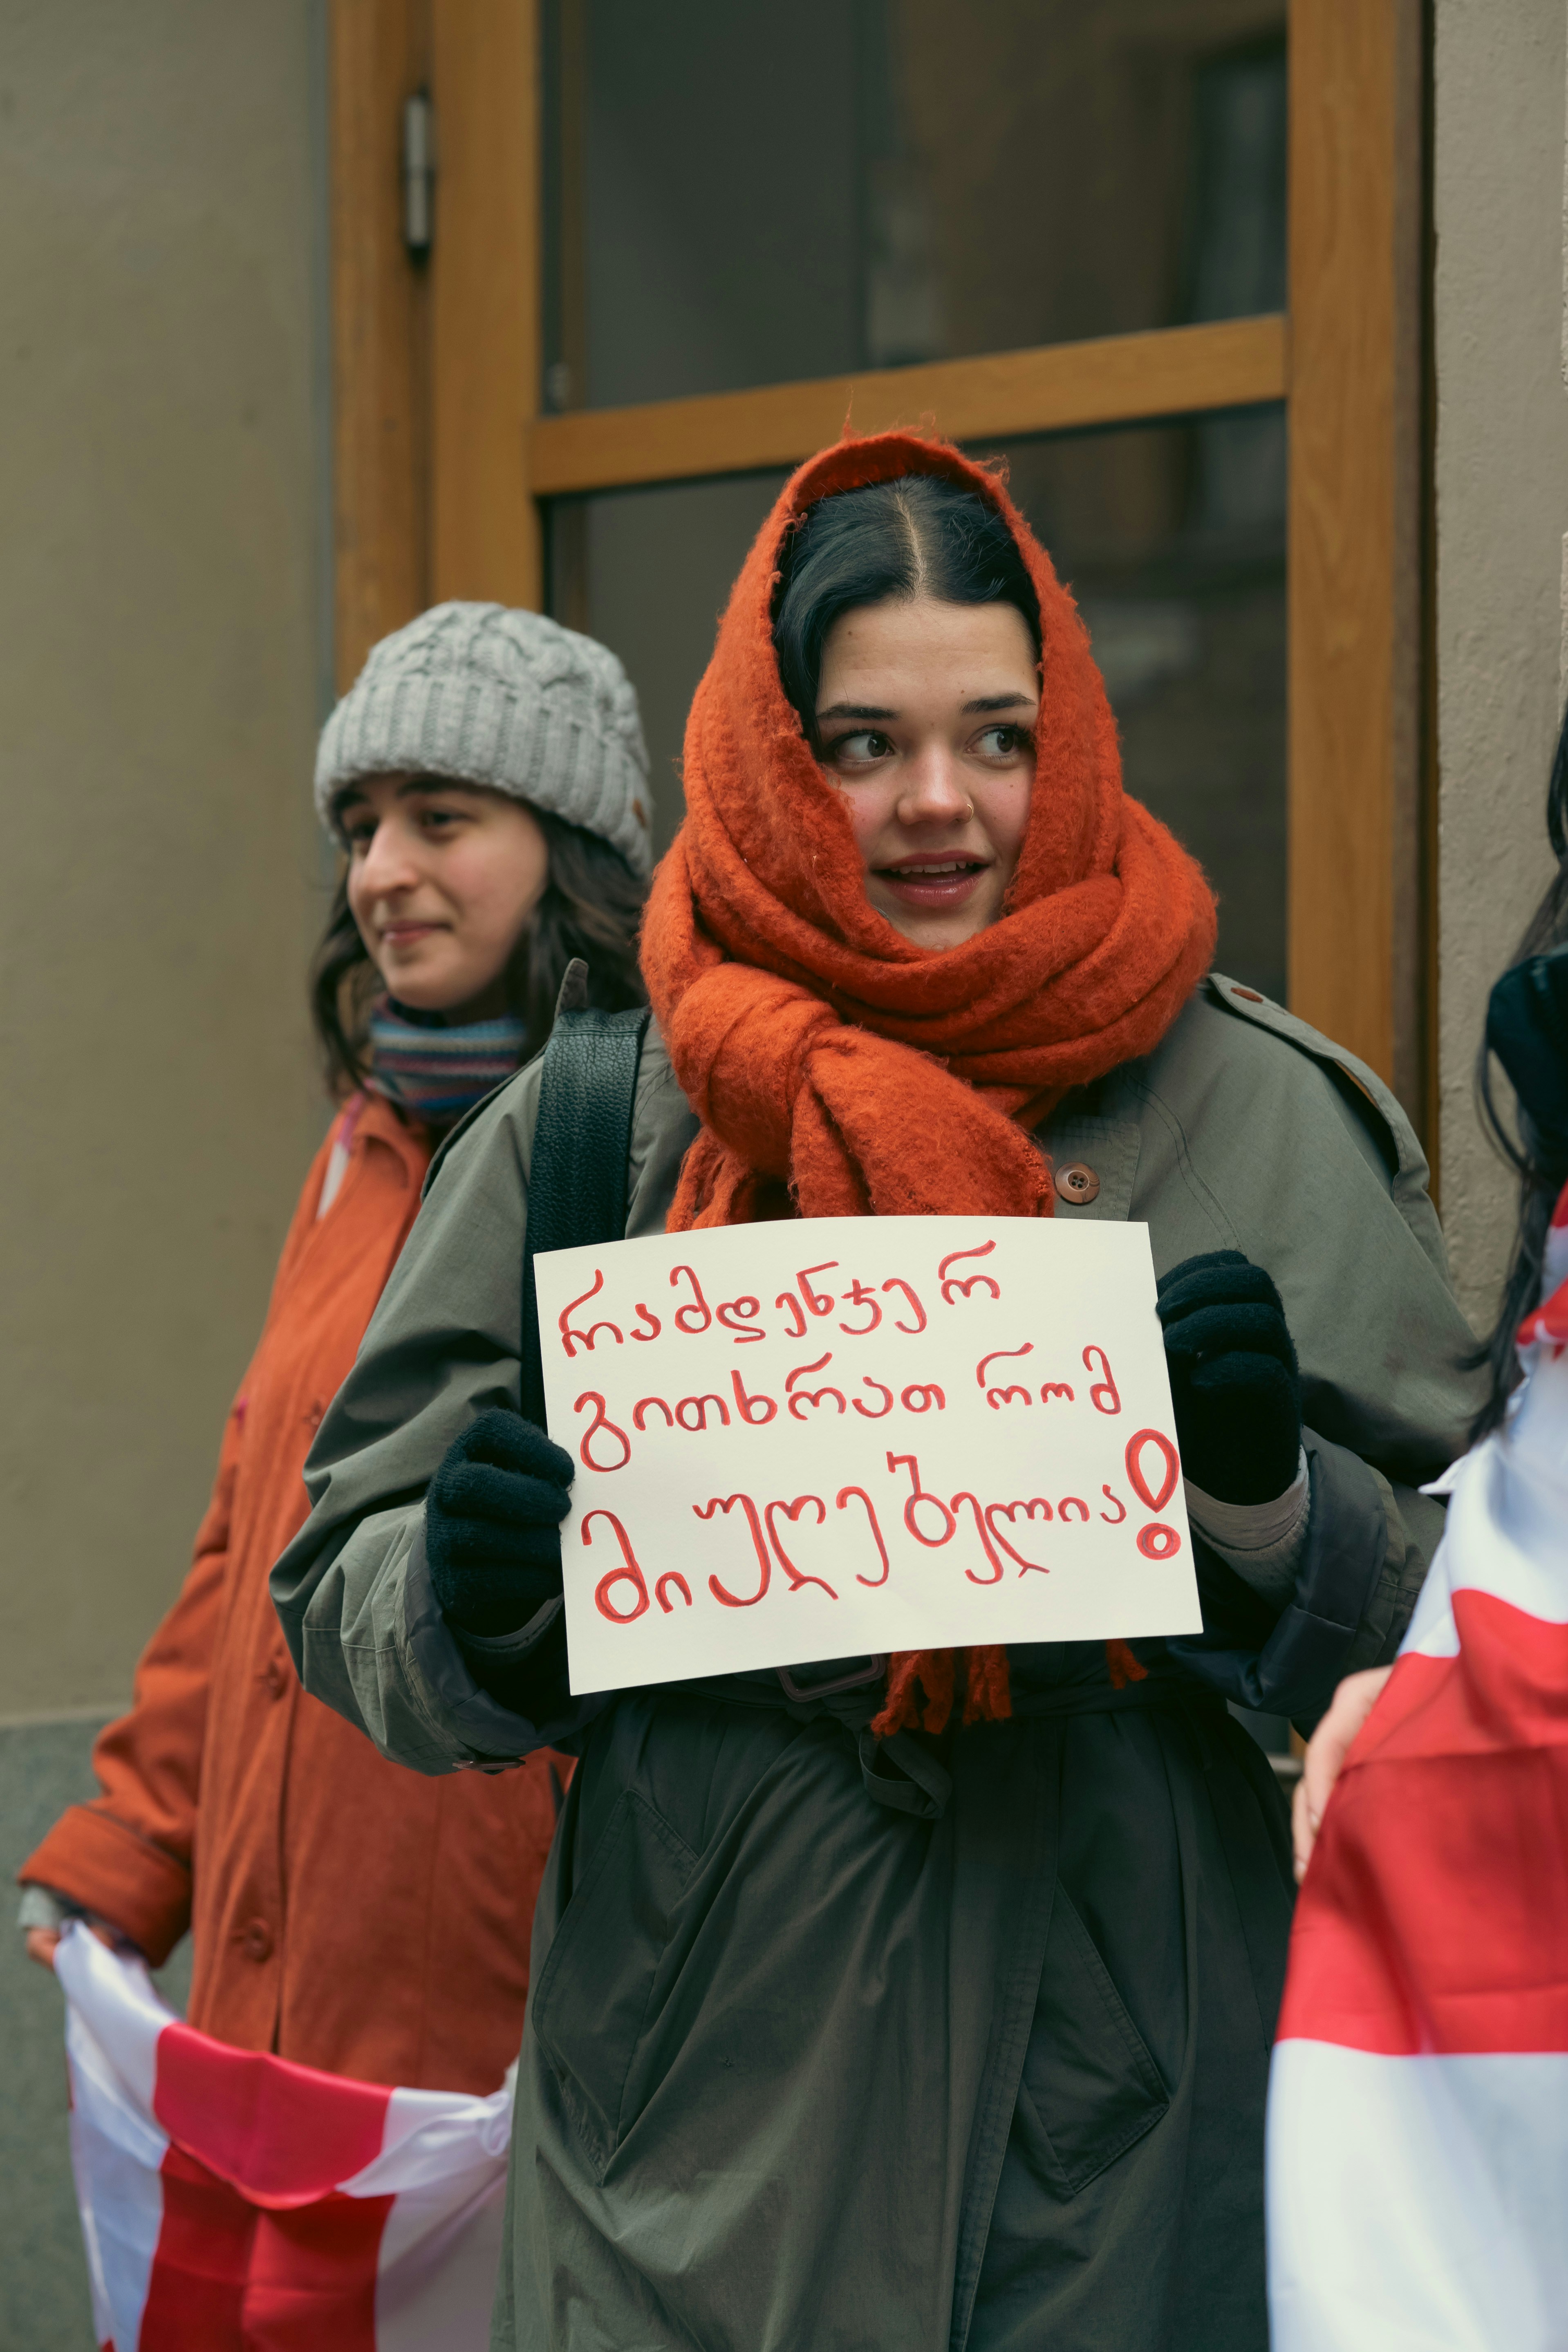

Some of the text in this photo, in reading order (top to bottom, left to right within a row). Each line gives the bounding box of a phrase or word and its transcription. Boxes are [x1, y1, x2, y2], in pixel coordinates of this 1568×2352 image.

[558, 1239, 1001, 1358] რამდენჯერ
[573, 1342, 1122, 1473] გითხრათ რომ
